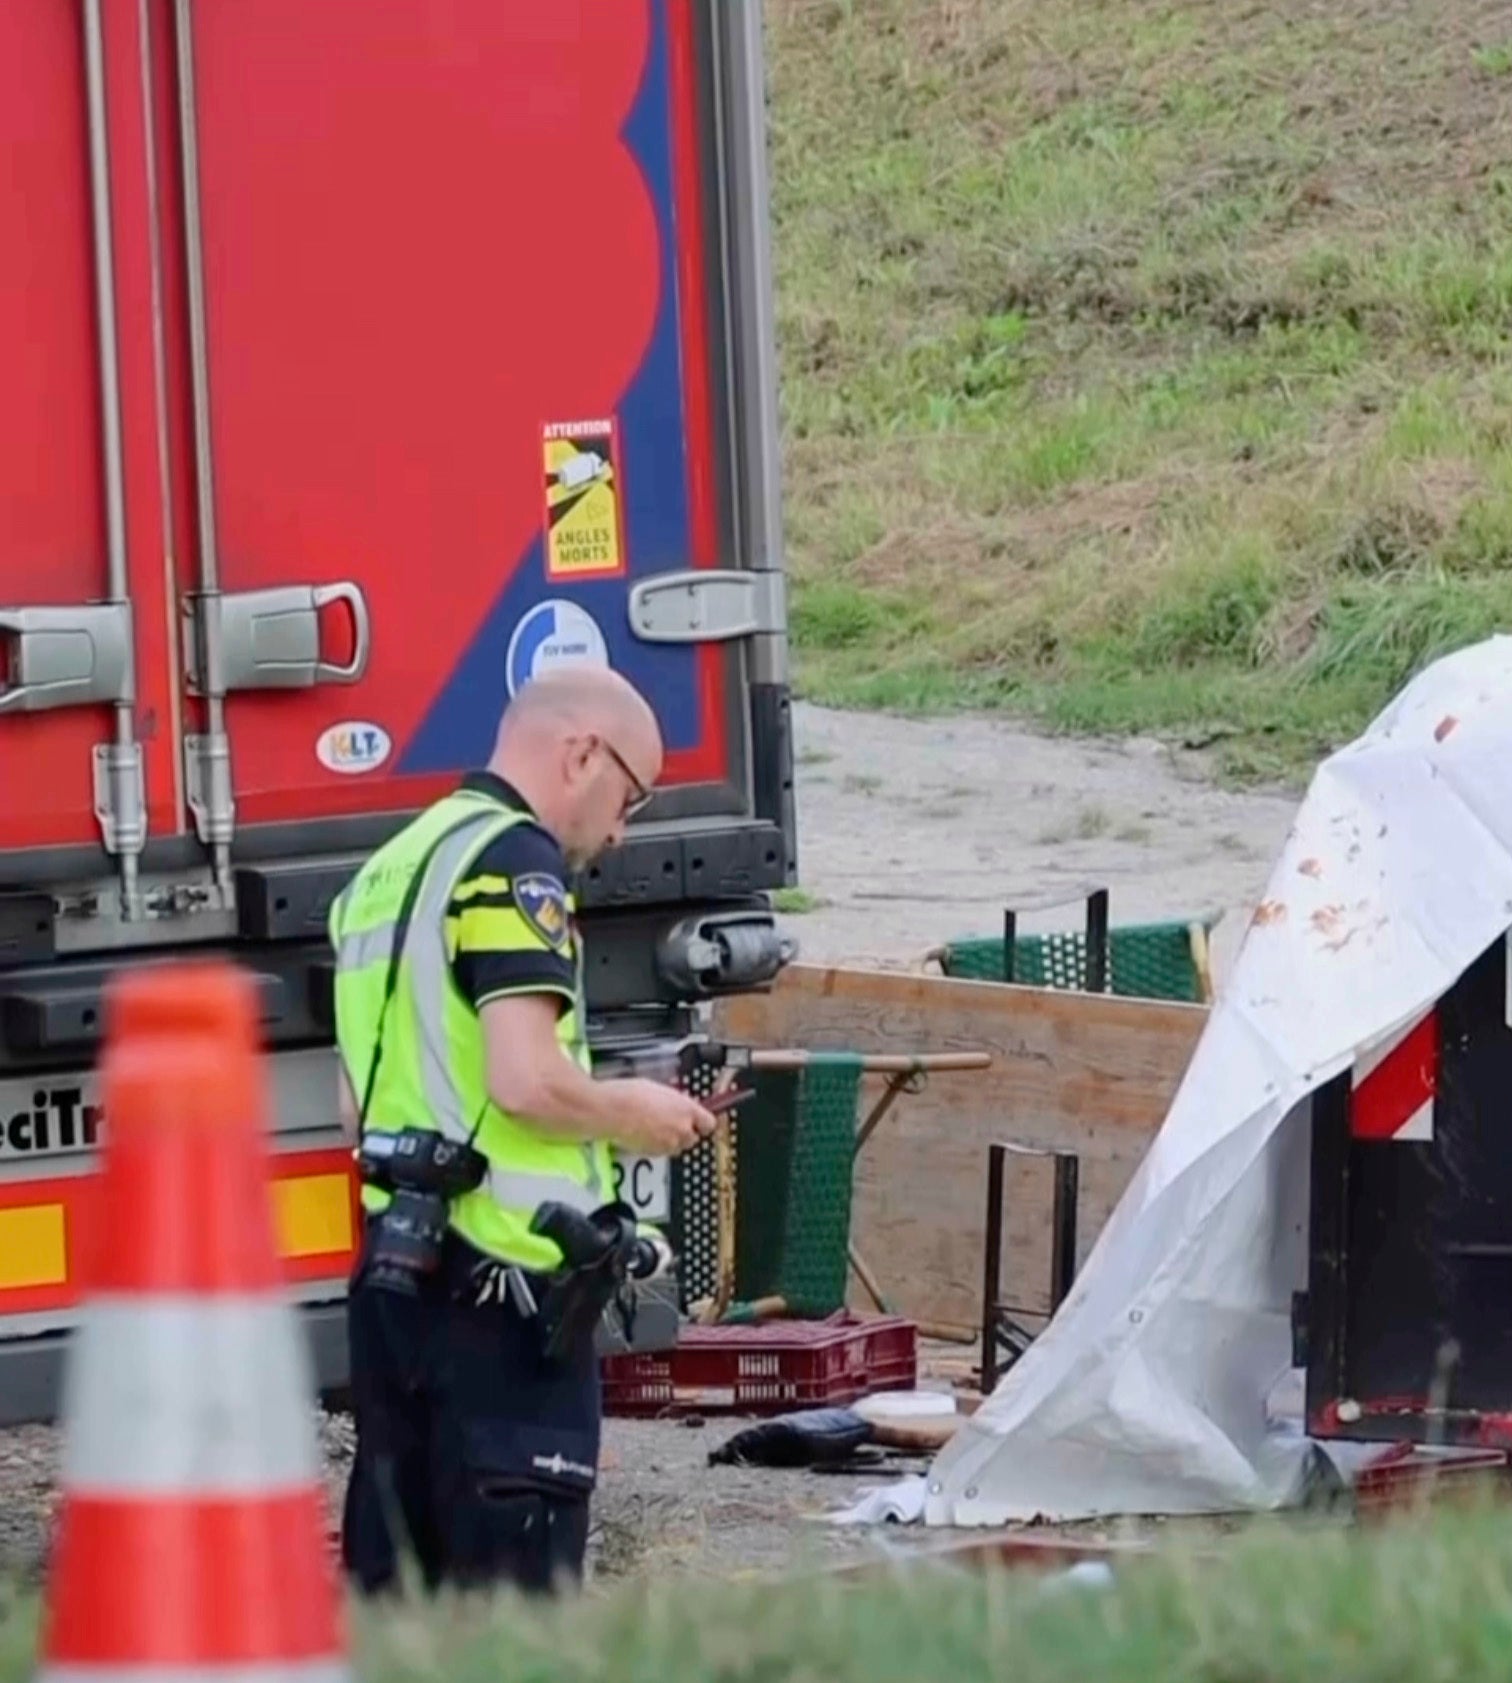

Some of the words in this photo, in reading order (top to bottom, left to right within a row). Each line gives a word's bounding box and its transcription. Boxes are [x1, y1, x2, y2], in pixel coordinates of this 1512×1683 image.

[543, 420, 612, 438] ATTENTION
[556, 528, 610, 546] ANGLES
[559, 546, 608, 563] MORTS
